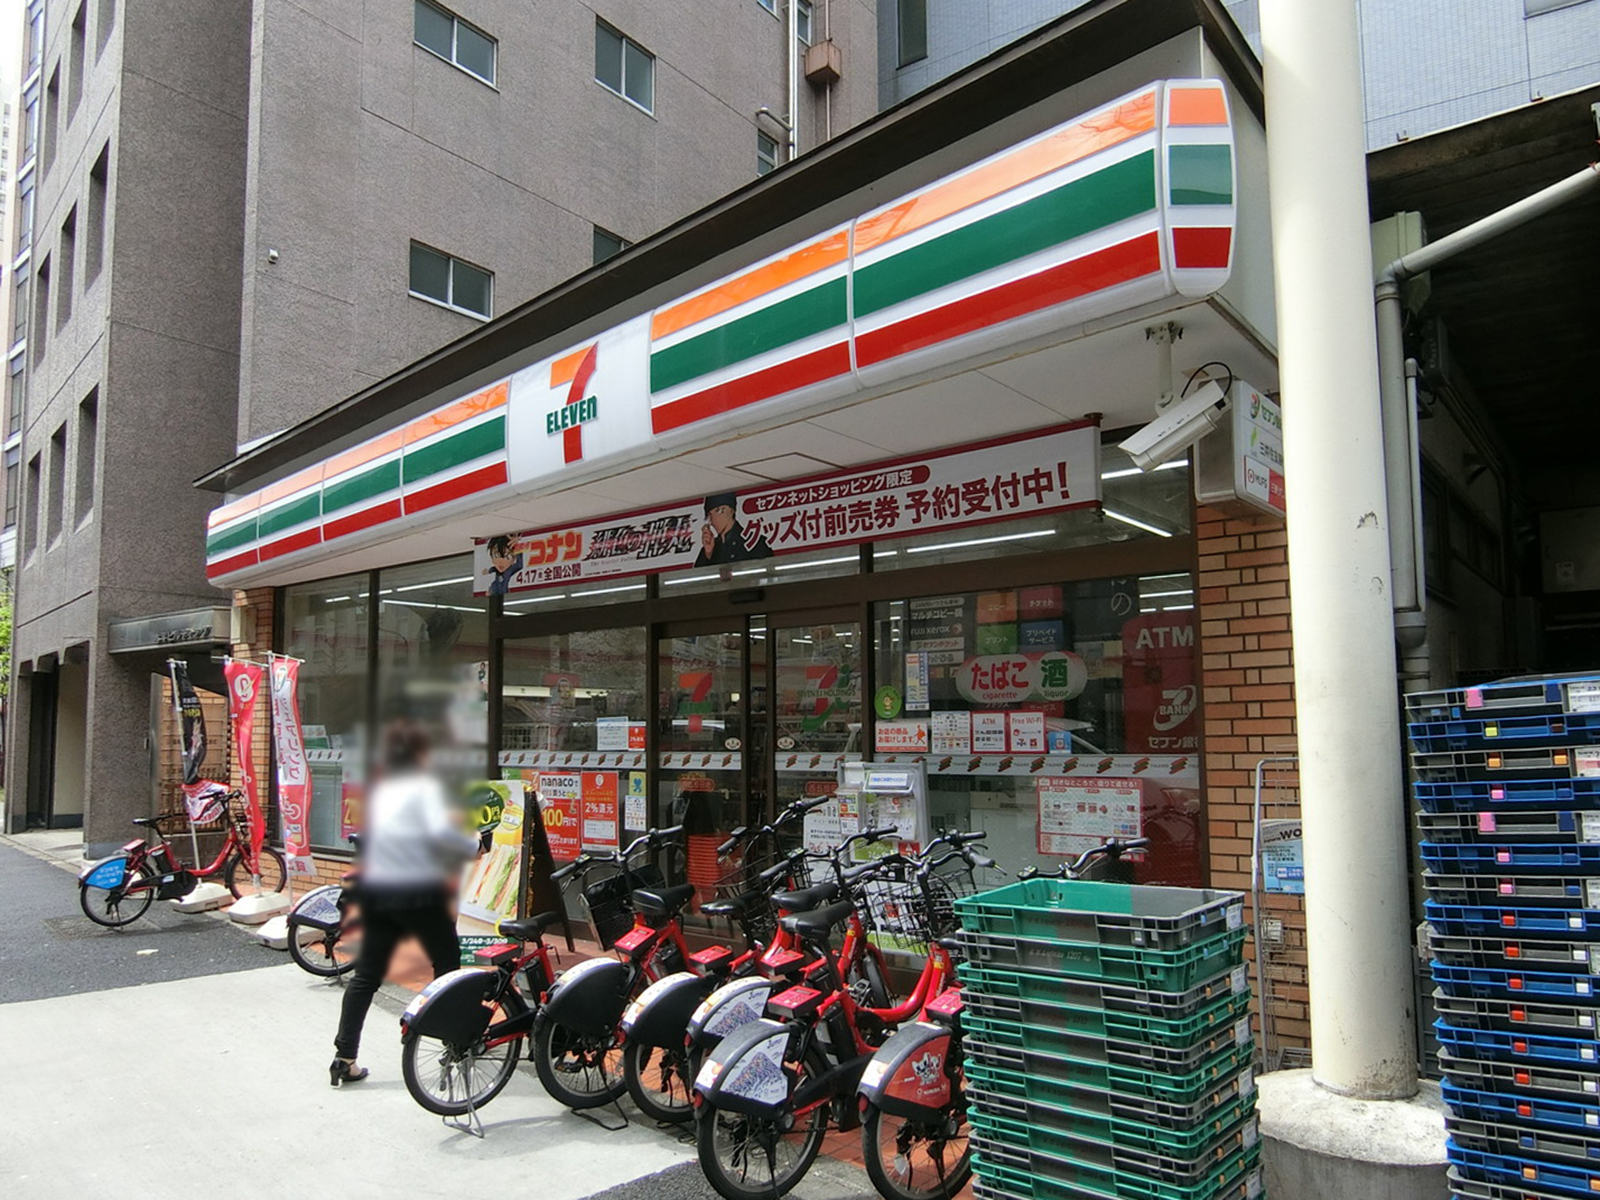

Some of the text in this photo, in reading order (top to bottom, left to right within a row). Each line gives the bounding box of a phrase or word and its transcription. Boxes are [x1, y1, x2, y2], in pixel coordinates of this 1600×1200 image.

[546, 395, 597, 434] ELEVEN
[755, 468, 913, 512] セブンネットショッピング限定
[911, 608, 963, 620] マルチコピー機
[1029, 636, 1055, 645] サービス
[1135, 625, 1194, 650] ATM
[971, 658, 1069, 691] たばこ 酒
[982, 689, 1070, 701] cigarette liquor
[1159, 704, 1190, 715] BANK
[585, 802, 615, 814] 2%還元
